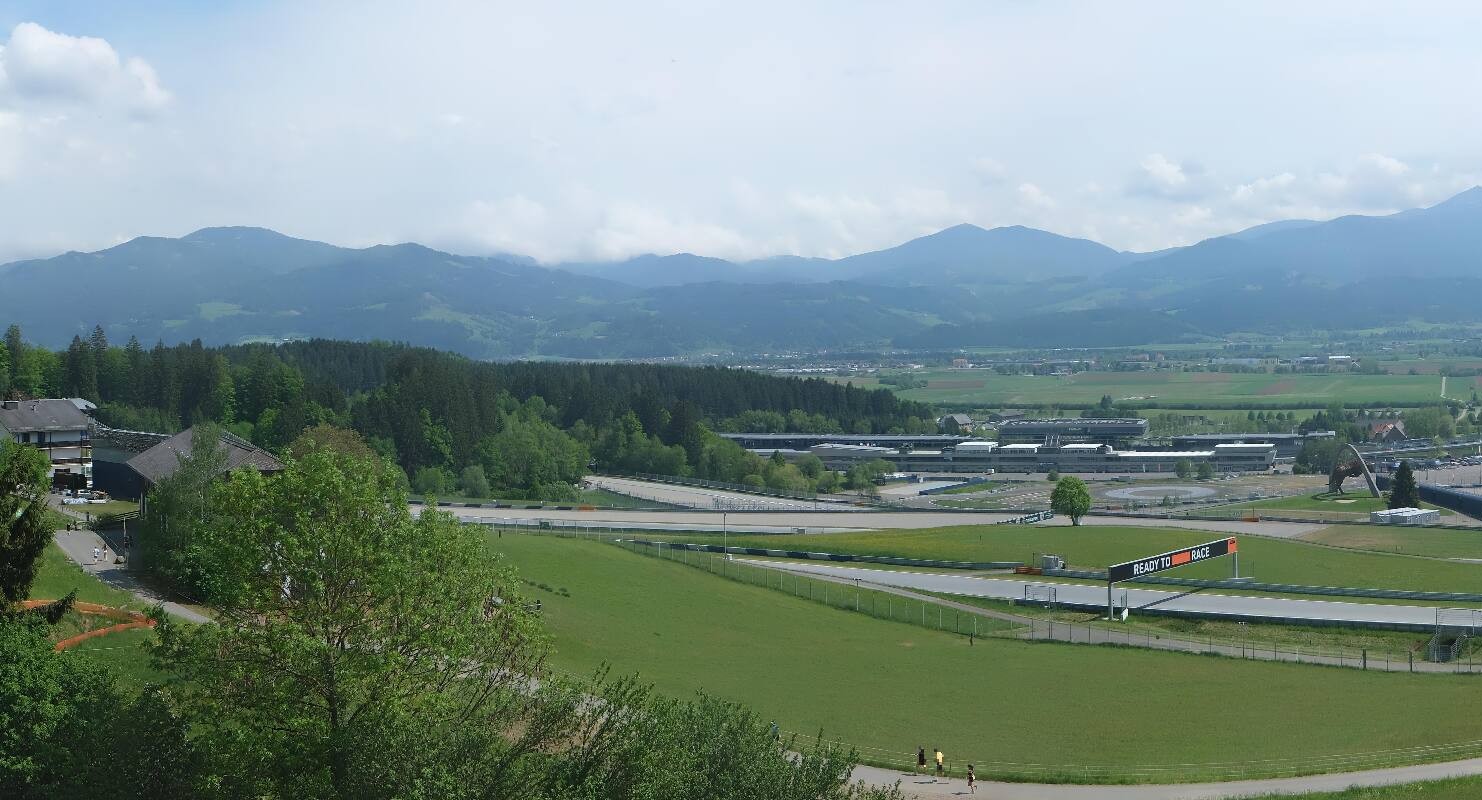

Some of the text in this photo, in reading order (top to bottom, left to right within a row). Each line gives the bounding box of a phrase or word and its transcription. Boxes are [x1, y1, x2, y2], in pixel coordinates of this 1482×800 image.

[1133, 546, 1210, 575] READY TO RACE
